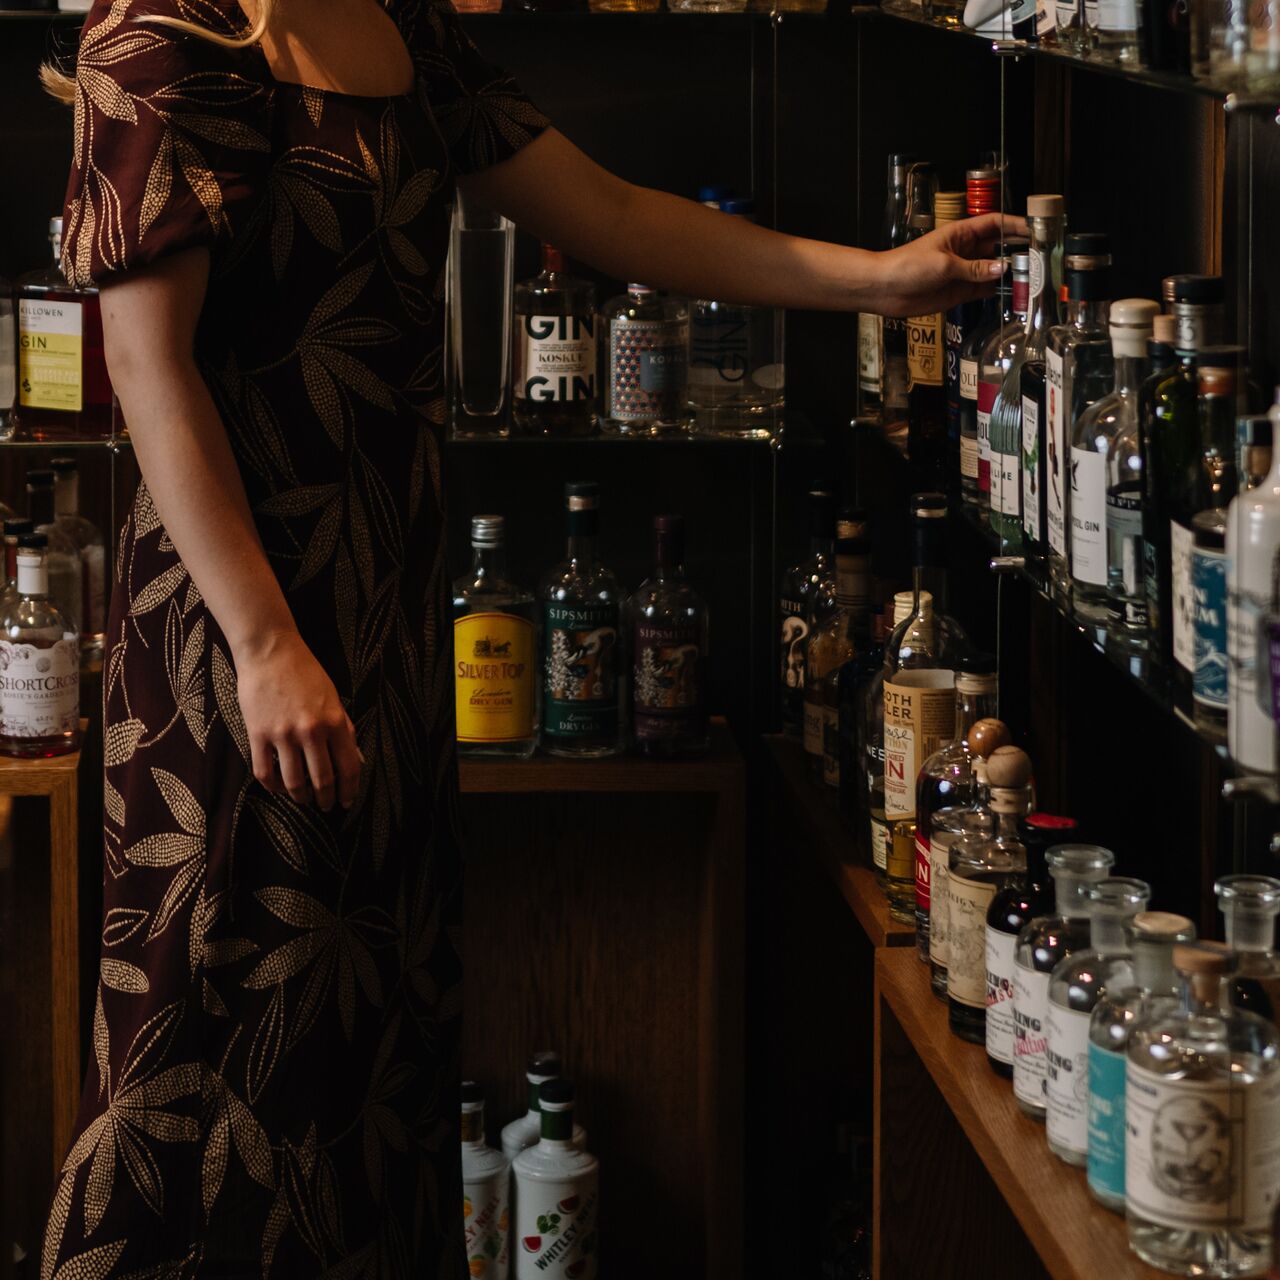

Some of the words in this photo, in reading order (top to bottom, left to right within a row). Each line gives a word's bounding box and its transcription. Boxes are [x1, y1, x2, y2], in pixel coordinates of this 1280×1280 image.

[21, 307, 63, 318] KILLOWEN
[524, 315, 594, 341] GIN
[20, 335, 48, 350] GIN
[539, 354, 583, 364] KOSKUE
[524, 374, 594, 402] GIN
[1085, 520, 1101, 533] GIN
[457, 661, 499, 680] SILVER
[501, 661, 527, 679] TOP
[0, 670, 80, 692] SHORTCROSS
[469, 697, 491, 706] DRY
[493, 697, 513, 706] GIN
[559, 721, 580, 731] DRY
[534, 1223, 578, 1271] WHITLEY
